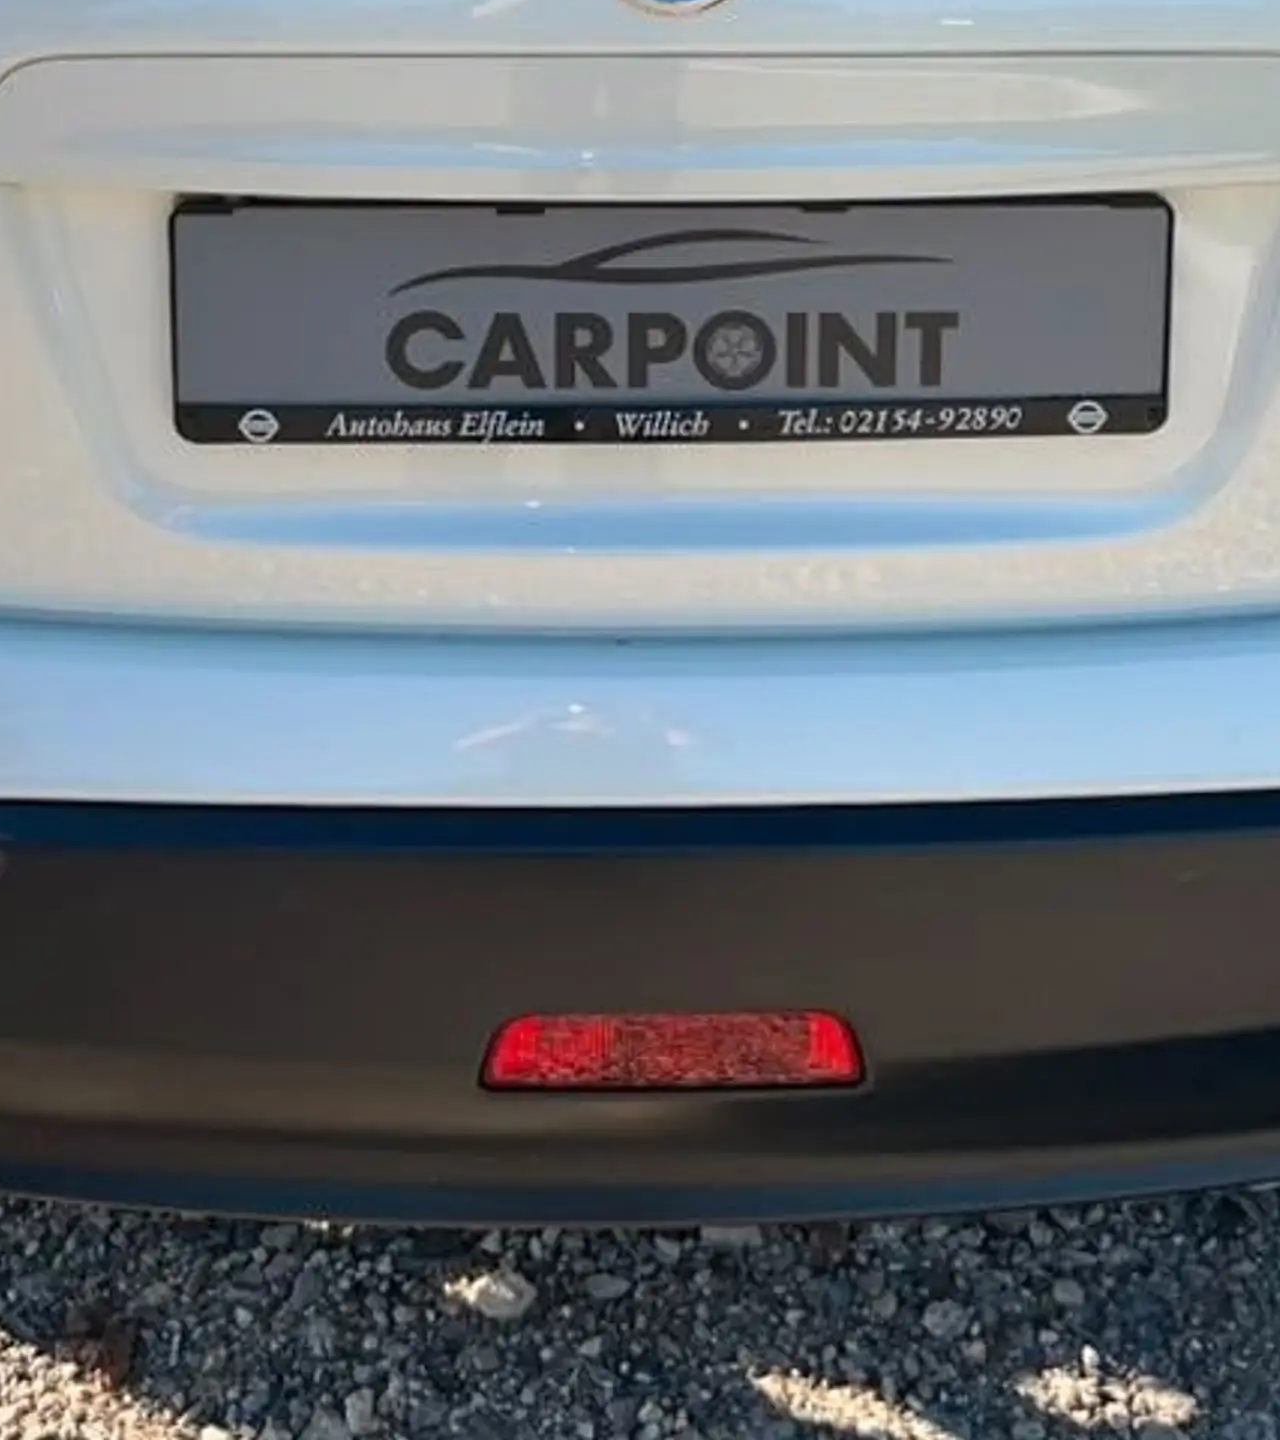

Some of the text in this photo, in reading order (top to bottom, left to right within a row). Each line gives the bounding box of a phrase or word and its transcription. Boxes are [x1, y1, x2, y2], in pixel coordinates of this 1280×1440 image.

[385, 309, 959, 389] CARPOINT
[325, 407, 1022, 443] Autohaus Elflein Willich Tel.: 02154-92890
